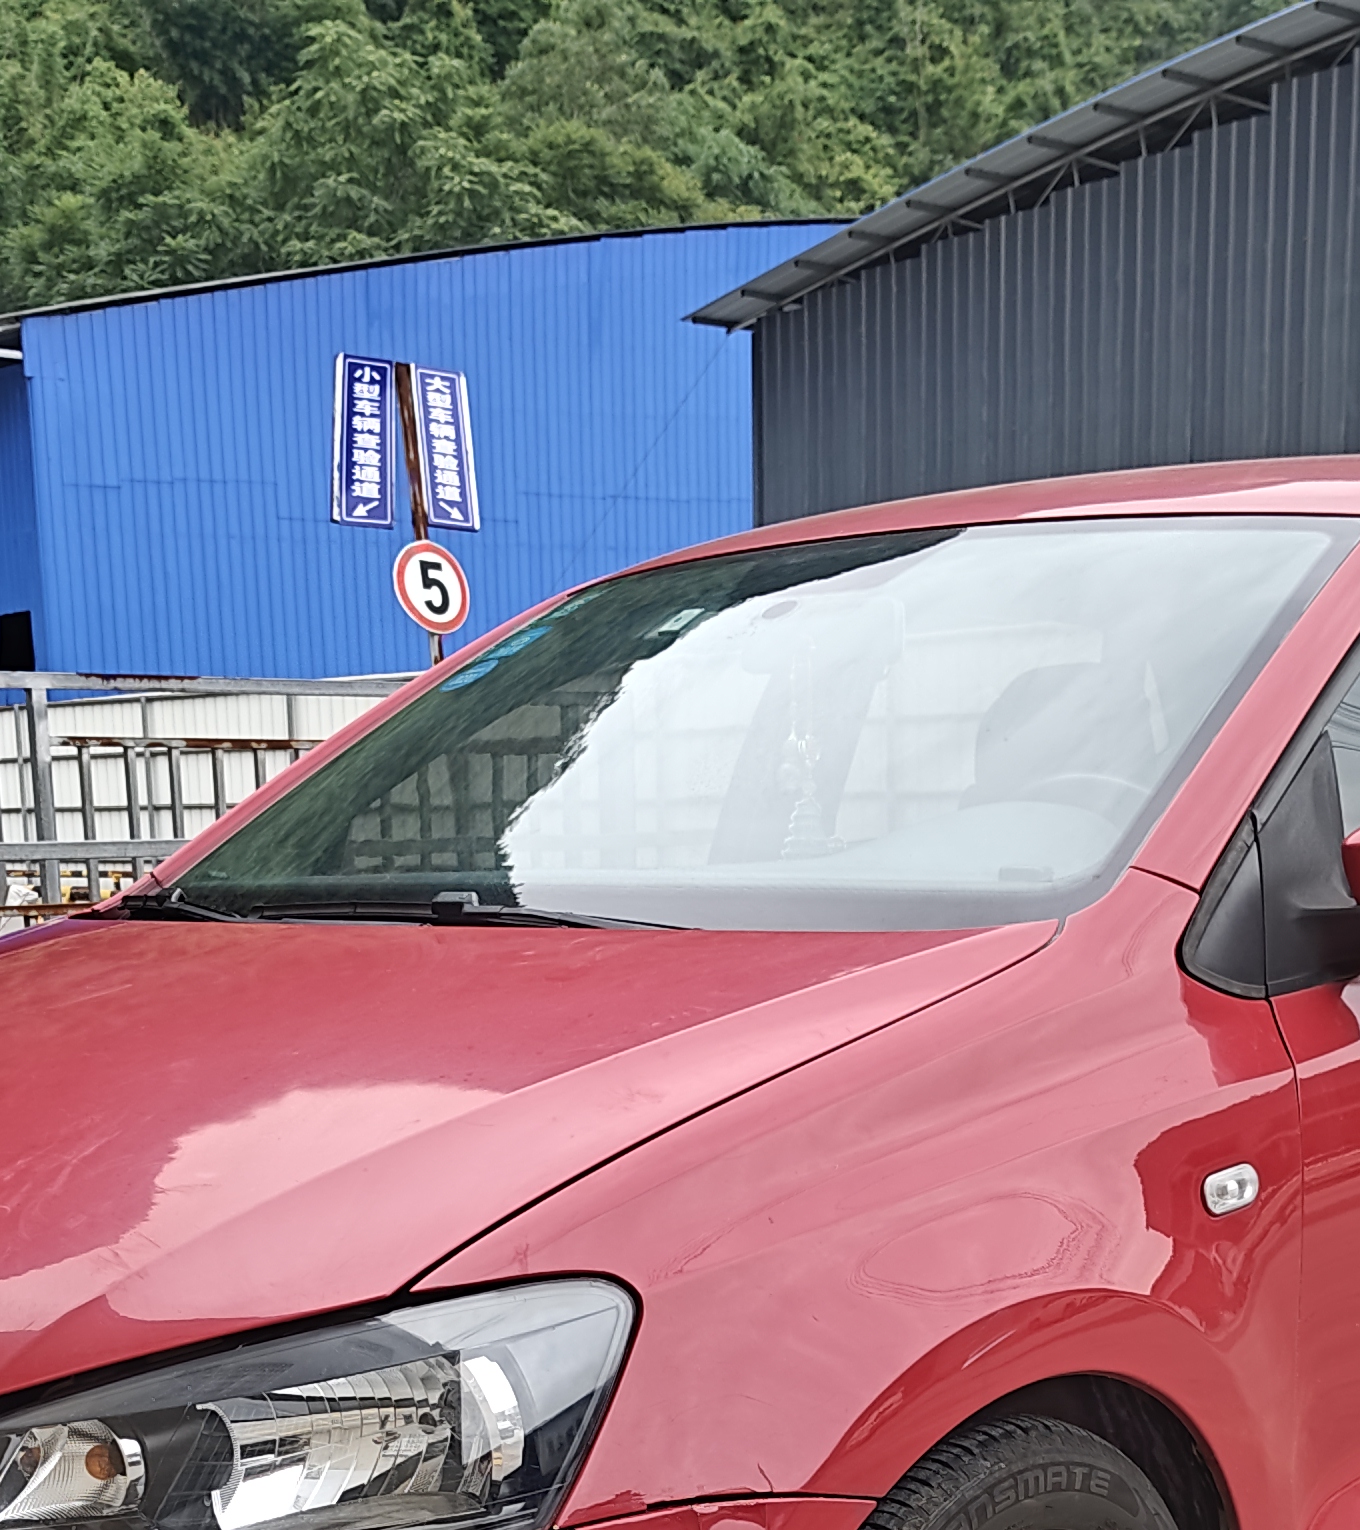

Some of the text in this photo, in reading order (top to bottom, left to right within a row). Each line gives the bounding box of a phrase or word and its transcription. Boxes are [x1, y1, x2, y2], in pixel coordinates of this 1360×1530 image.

[351, 366, 381, 499] 小型车辆查验通道
[425, 375, 463, 502] 大型车辆查验通道
[419, 559, 450, 616] 5
